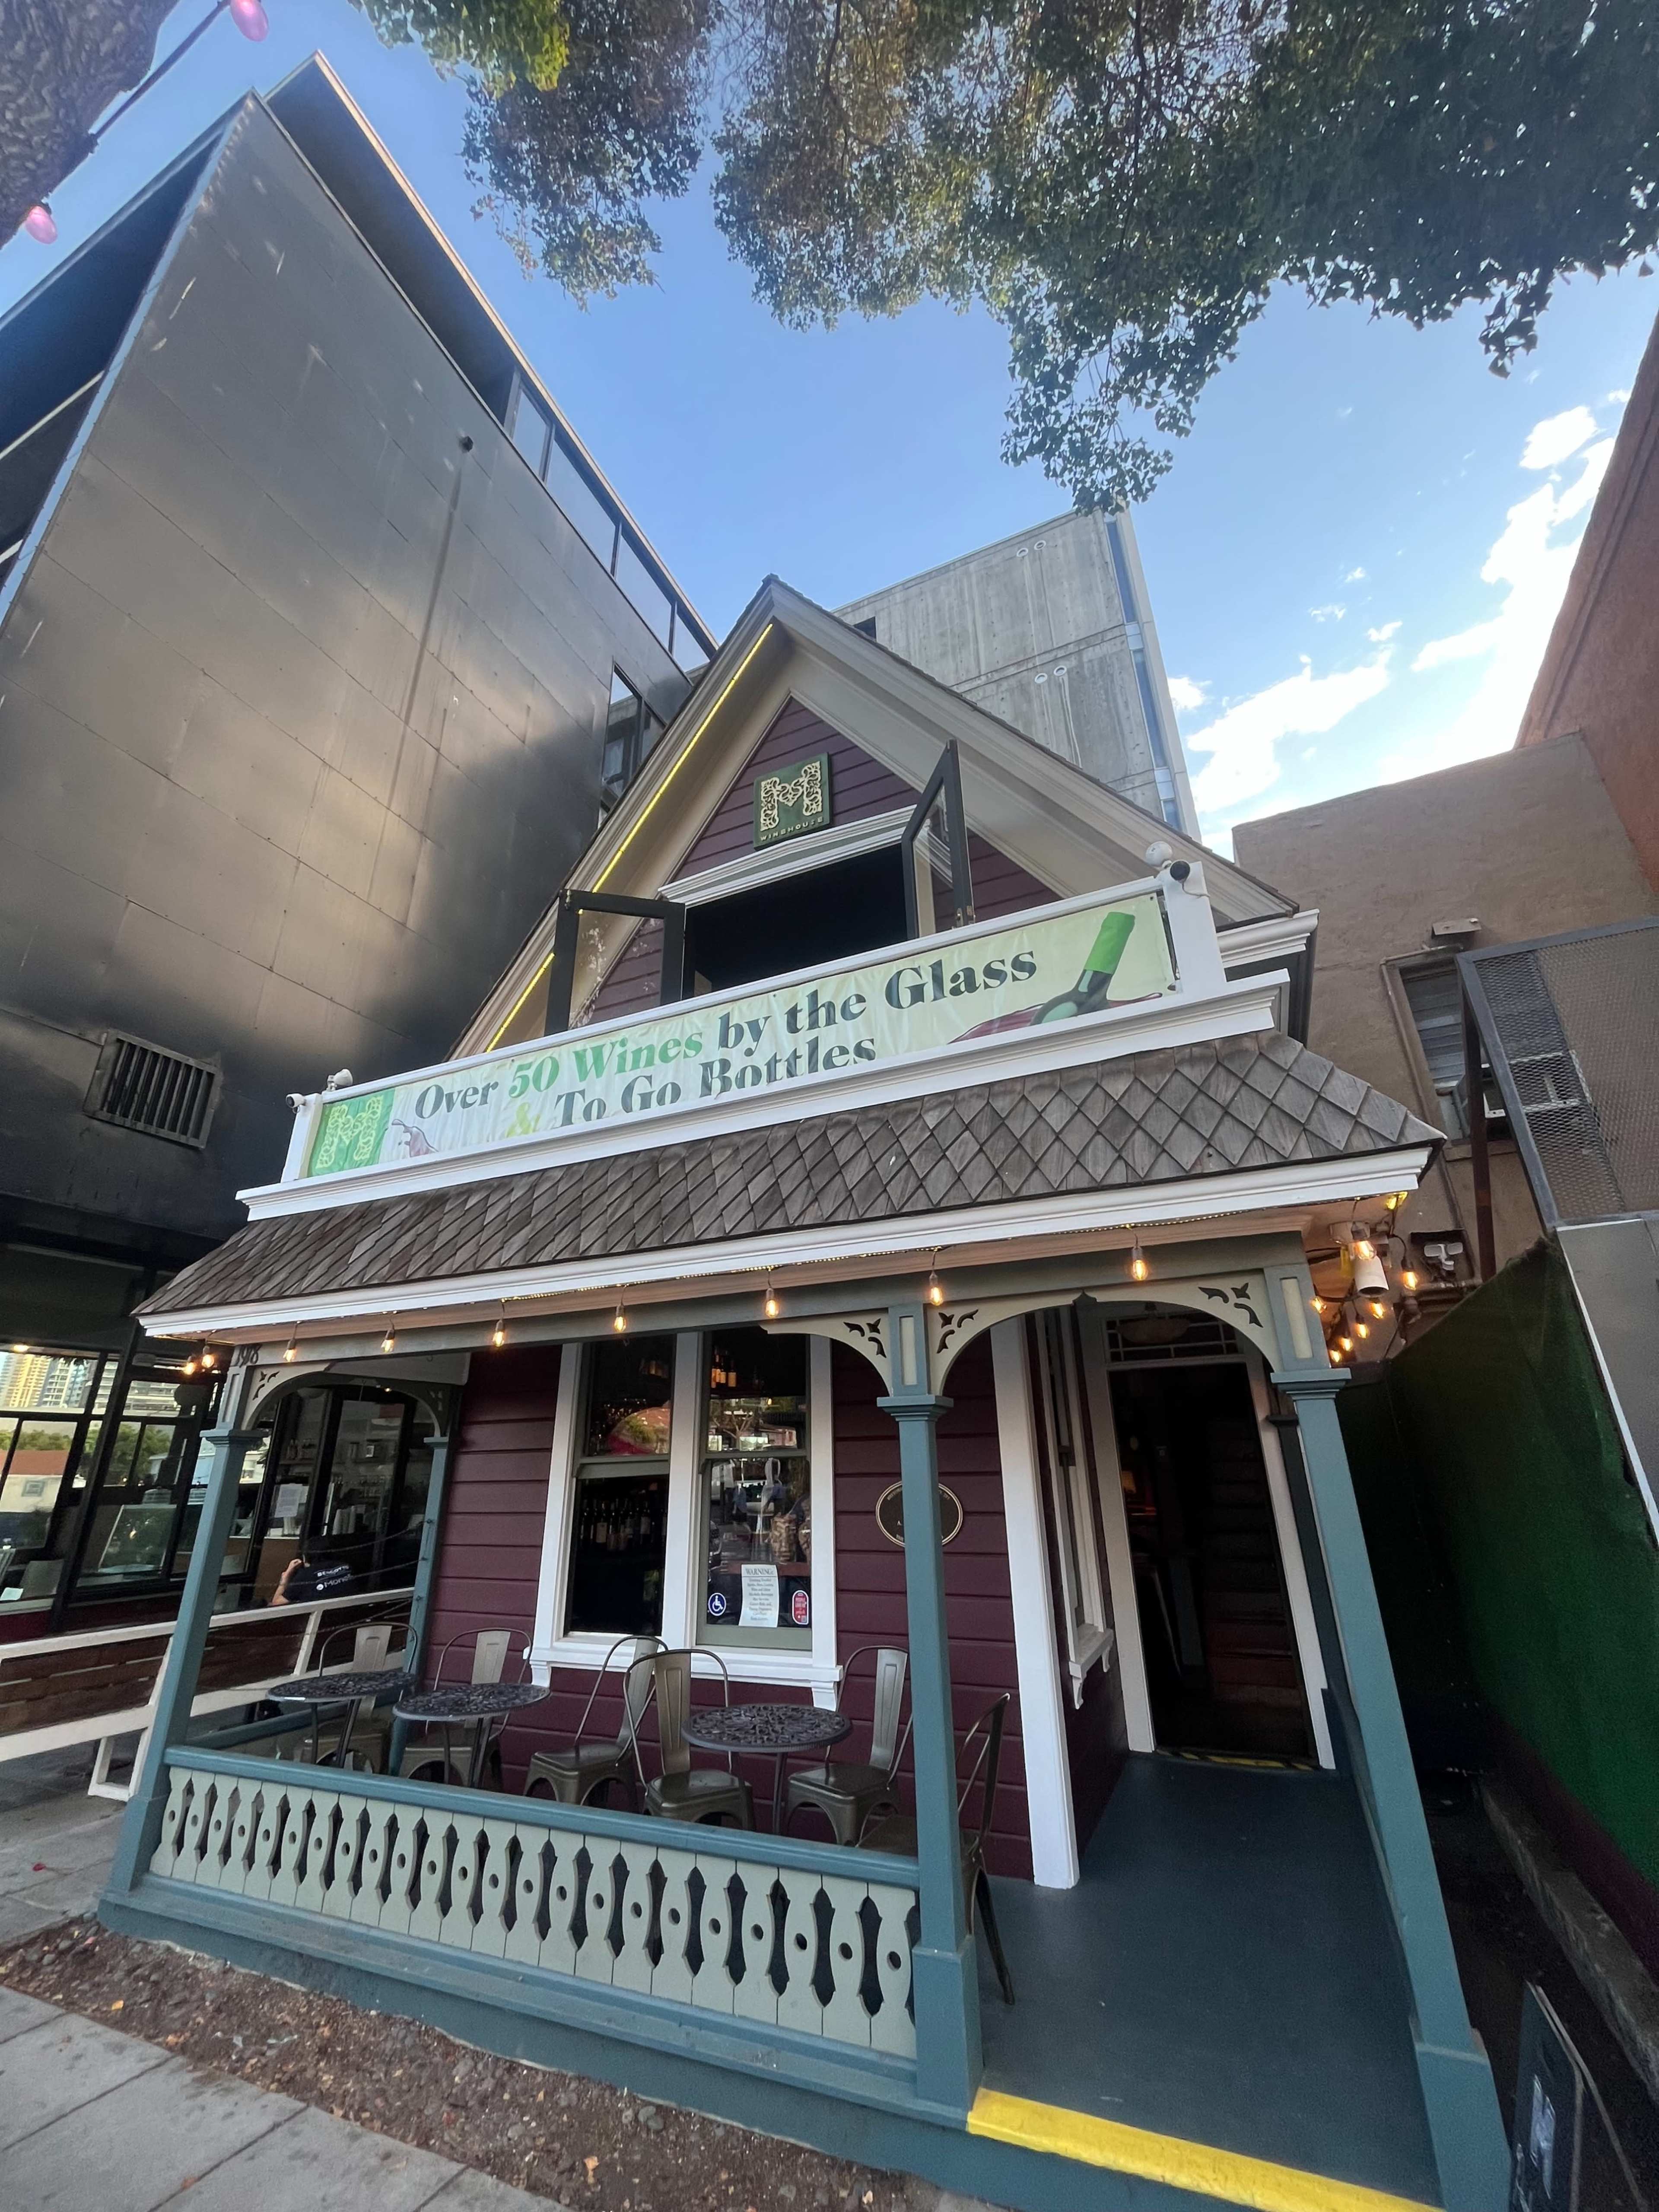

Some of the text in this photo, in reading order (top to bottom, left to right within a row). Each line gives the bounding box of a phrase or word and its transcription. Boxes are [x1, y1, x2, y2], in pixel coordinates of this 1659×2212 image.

[760, 816, 823, 841] WINEHOUSE
[415, 950, 1037, 1119] Over 50 Wines by the Glass
[505, 1036, 876, 1138] & To Go Bottles
